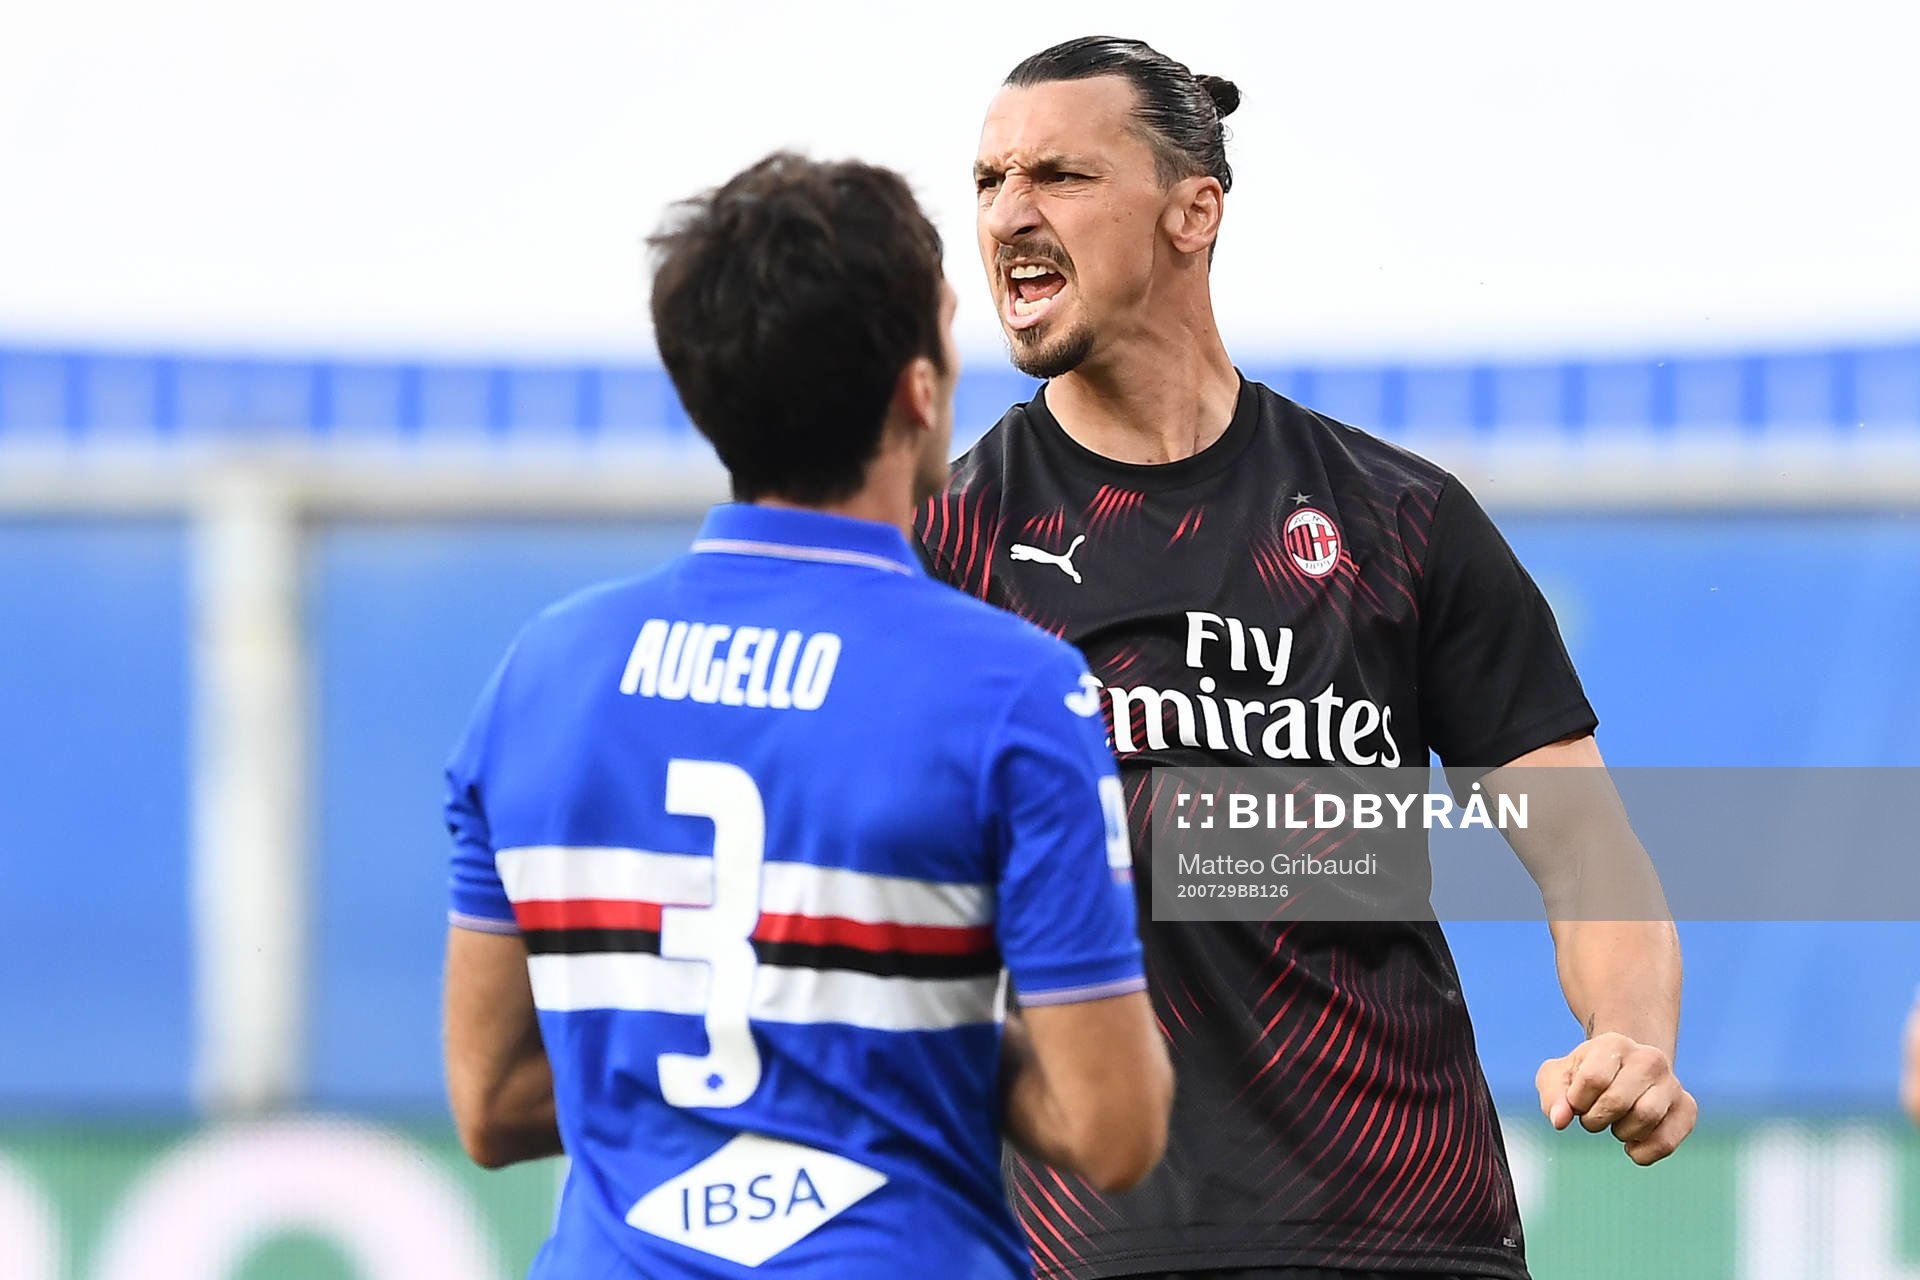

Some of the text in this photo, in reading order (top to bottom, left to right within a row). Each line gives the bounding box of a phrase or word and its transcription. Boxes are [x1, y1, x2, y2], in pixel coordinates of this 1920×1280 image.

[618, 618, 842, 711] AUGELLO
[1185, 611, 1294, 686] Fly
[1096, 676, 1401, 769] mirates
[656, 757, 766, 1108] 3
[681, 1167, 826, 1232] IBSA
